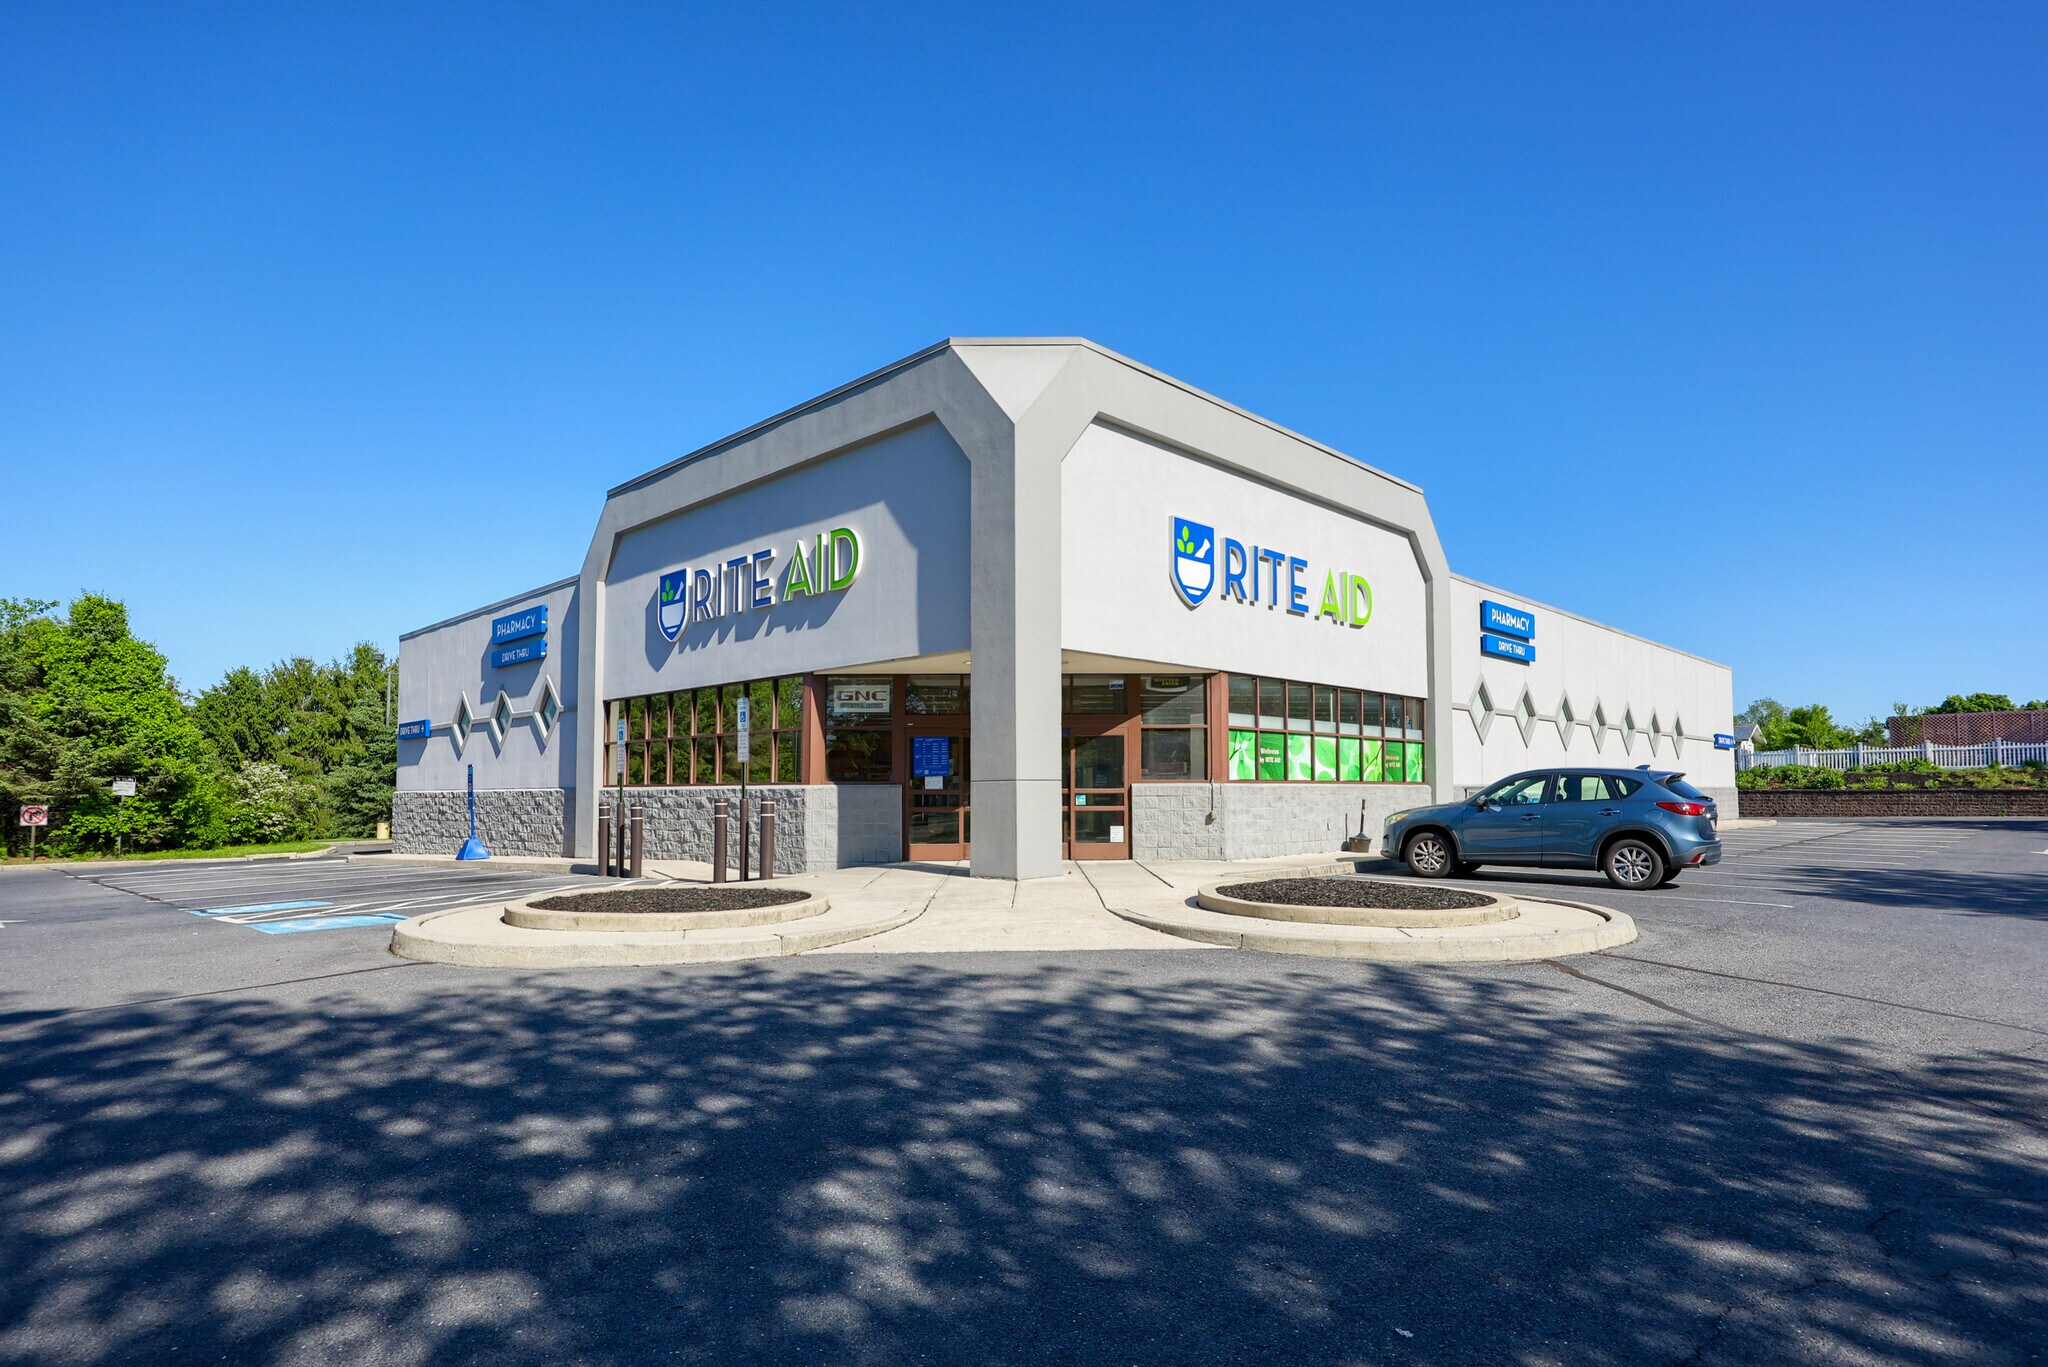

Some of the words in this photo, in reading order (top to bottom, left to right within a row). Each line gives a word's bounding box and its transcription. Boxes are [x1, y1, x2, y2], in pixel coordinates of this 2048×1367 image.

[693, 548, 776, 623] RITE
[782, 527, 864, 602] AID
[1220, 536, 1310, 615] RITE
[1315, 567, 1373, 628] AID
[497, 615, 536, 637] PHARMACY
[1491, 607, 1530, 631] PHARMACY
[501, 650, 516, 663] DRIVE
[516, 647, 530, 659] THRU
[1498, 640, 1513, 653] DRIVE
[1513, 643, 1526, 656] THRU
[836, 690, 887, 701] GNC
